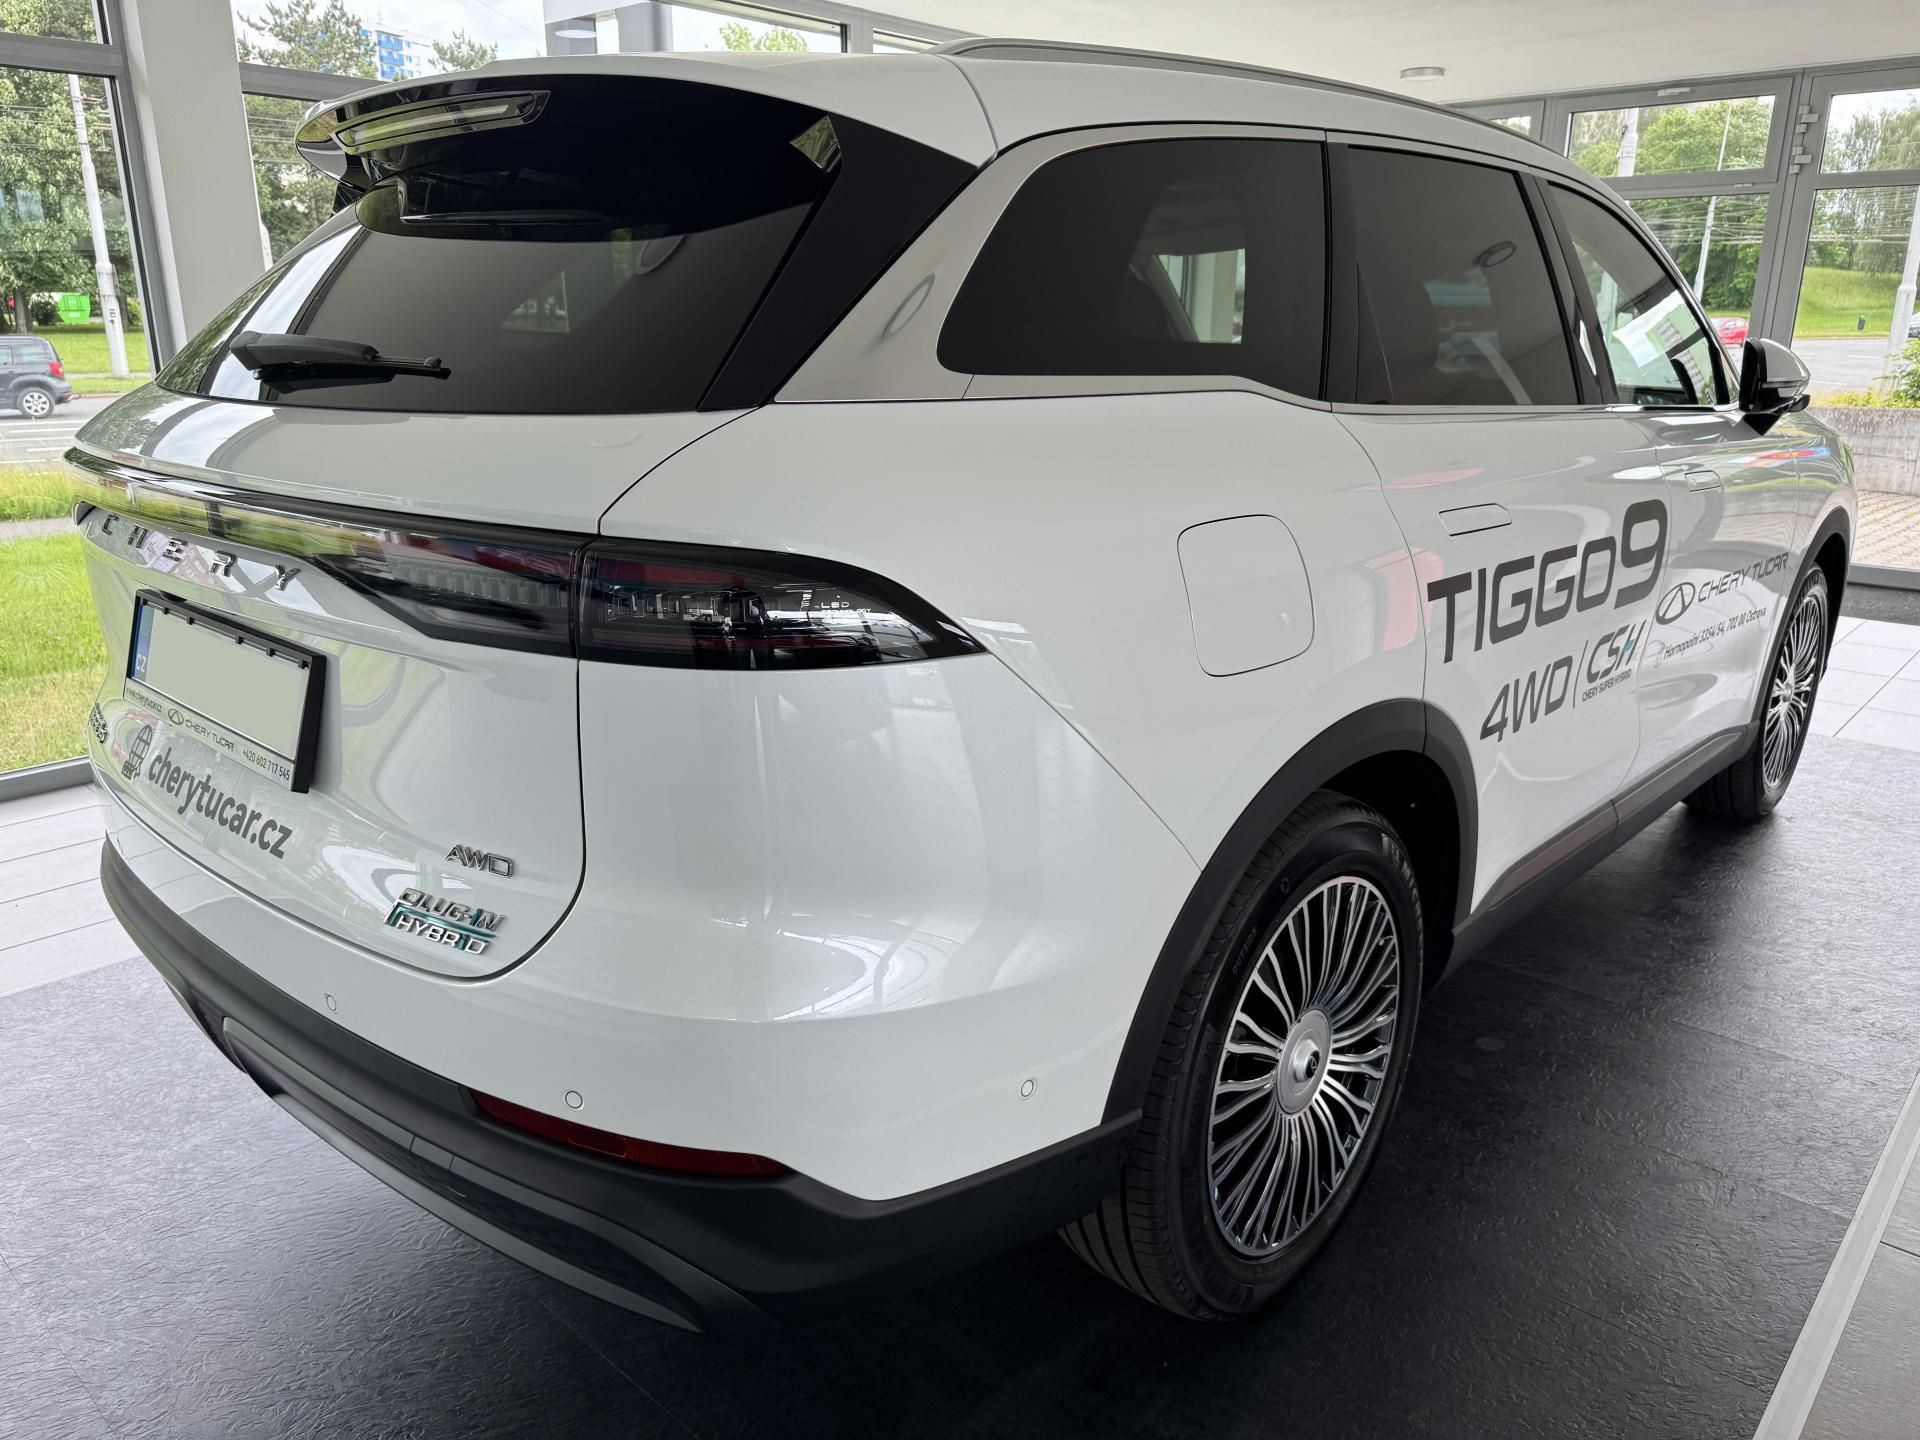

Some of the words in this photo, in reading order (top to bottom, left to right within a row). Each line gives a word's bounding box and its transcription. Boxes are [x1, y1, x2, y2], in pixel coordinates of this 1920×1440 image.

[101, 514, 301, 591] CHERY
[1698, 566, 1750, 603] CHERY
[1752, 552, 1789, 581] TUCAR
[136, 654, 147, 673] CZ
[1587, 620, 1647, 684] CSH
[1479, 655, 1573, 742] 4WD
[1582, 685, 1598, 703] CHERY
[1598, 676, 1615, 693] SUPER
[1614, 668, 1632, 684] HYBRID
[185, 719, 212, 738] CHERY
[211, 732, 236, 752] TUCAR
[242, 748, 256, 763] +420
[255, 754, 267, 769] 602
[267, 760, 279, 774] 717
[279, 766, 291, 781] 545
[148, 747, 293, 860] cherytucar.cz
[445, 844, 515, 878] AWD
